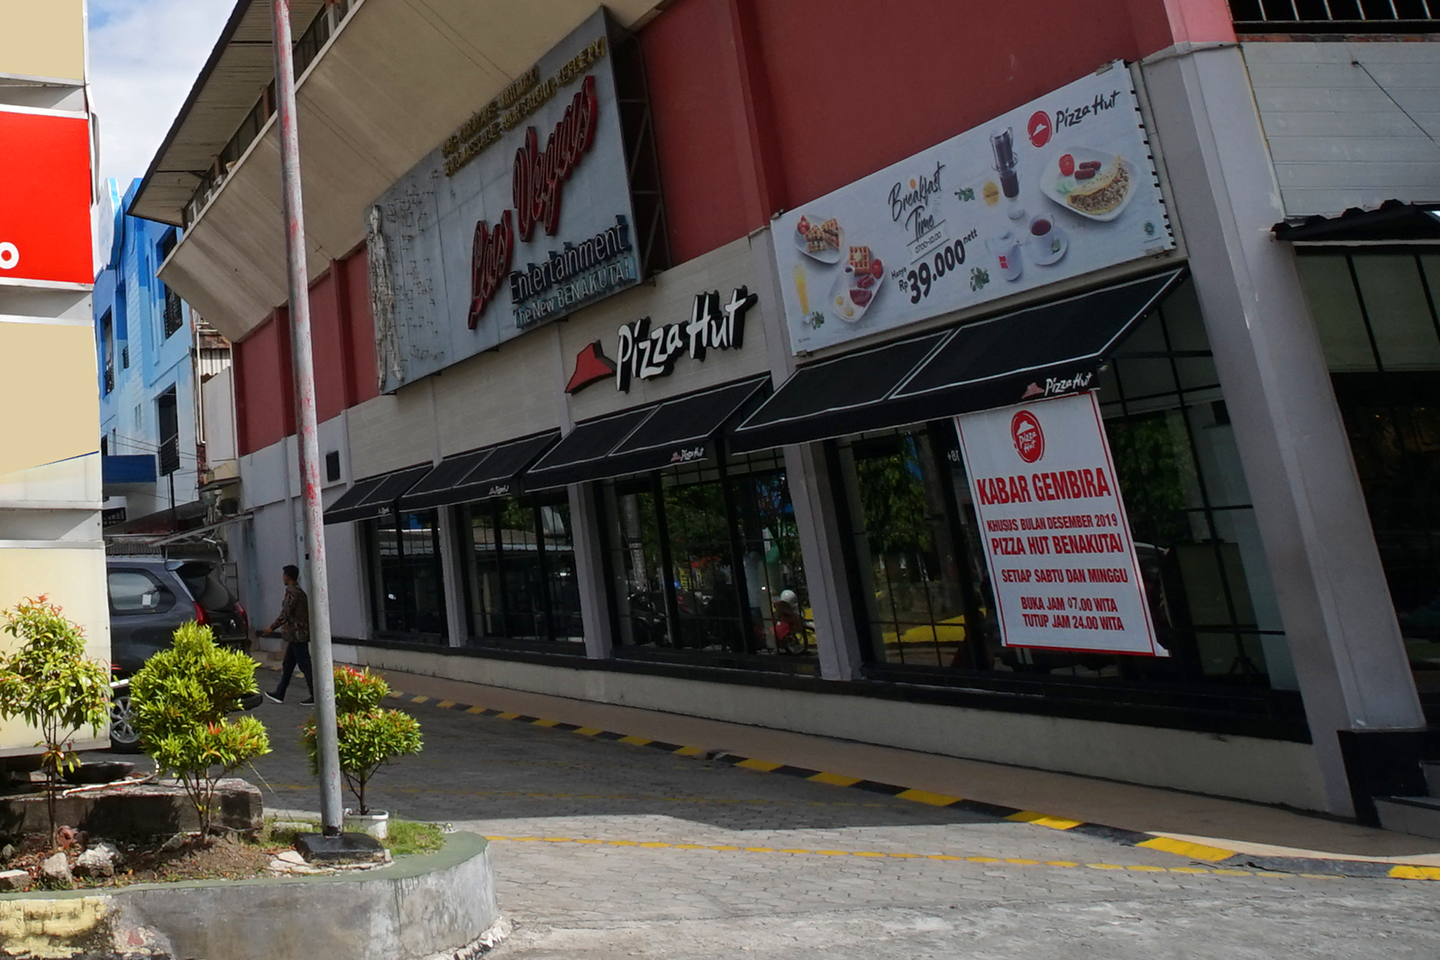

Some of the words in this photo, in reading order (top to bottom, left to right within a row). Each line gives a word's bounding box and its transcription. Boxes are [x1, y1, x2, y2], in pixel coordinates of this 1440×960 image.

[1055, 107, 1092, 134] Pizza
[1091, 89, 1122, 116] Hut
[887, 160, 947, 222] Breakfast
[905, 204, 935, 242] Time
[508, 216, 631, 305] Entertainment
[907, 238, 966, 305] 39.000
[963, 227, 978, 245] nett
[532, 299, 556, 320] New
[556, 256, 635, 309] BENAKUTAI
[616, 318, 685, 392] Pizza
[686, 287, 753, 360] Hut
[1044, 377, 1073, 396] Pizza
[1072, 372, 1093, 389] Hut
[1018, 431, 1037, 449] Pizza
[1023, 440, 1037, 454] Hut
[977, 474, 1033, 506] KABAR
[1032, 467, 1112, 503] GEMBIRA
[986, 518, 1019, 533] KHUSUS
[1021, 517, 1047, 531] BULAN
[1047, 514, 1094, 530] DESEMBER
[1094, 513, 1118, 528] 2019
[991, 536, 1025, 556] PIZZA
[1029, 535, 1051, 555] HUT
[1053, 533, 1125, 555] BENAKUTAI
[1001, 569, 1032, 583] SETIAP
[1035, 569, 1064, 583] SABTU
[1066, 569, 1086, 583] DAN
[1087, 568, 1128, 583] MINGGU
[1021, 596, 1046, 611] BUKA
[1047, 597, 1066, 611] JAM
[1067, 597, 1093, 611] 07.00
[1093, 598, 1118, 613] WITA
[1022, 614, 1050, 628] TUTUP
[1052, 615, 1071, 629] JAM
[1072, 616, 1099, 630] 24.00
[1099, 617, 1125, 631] WITA
